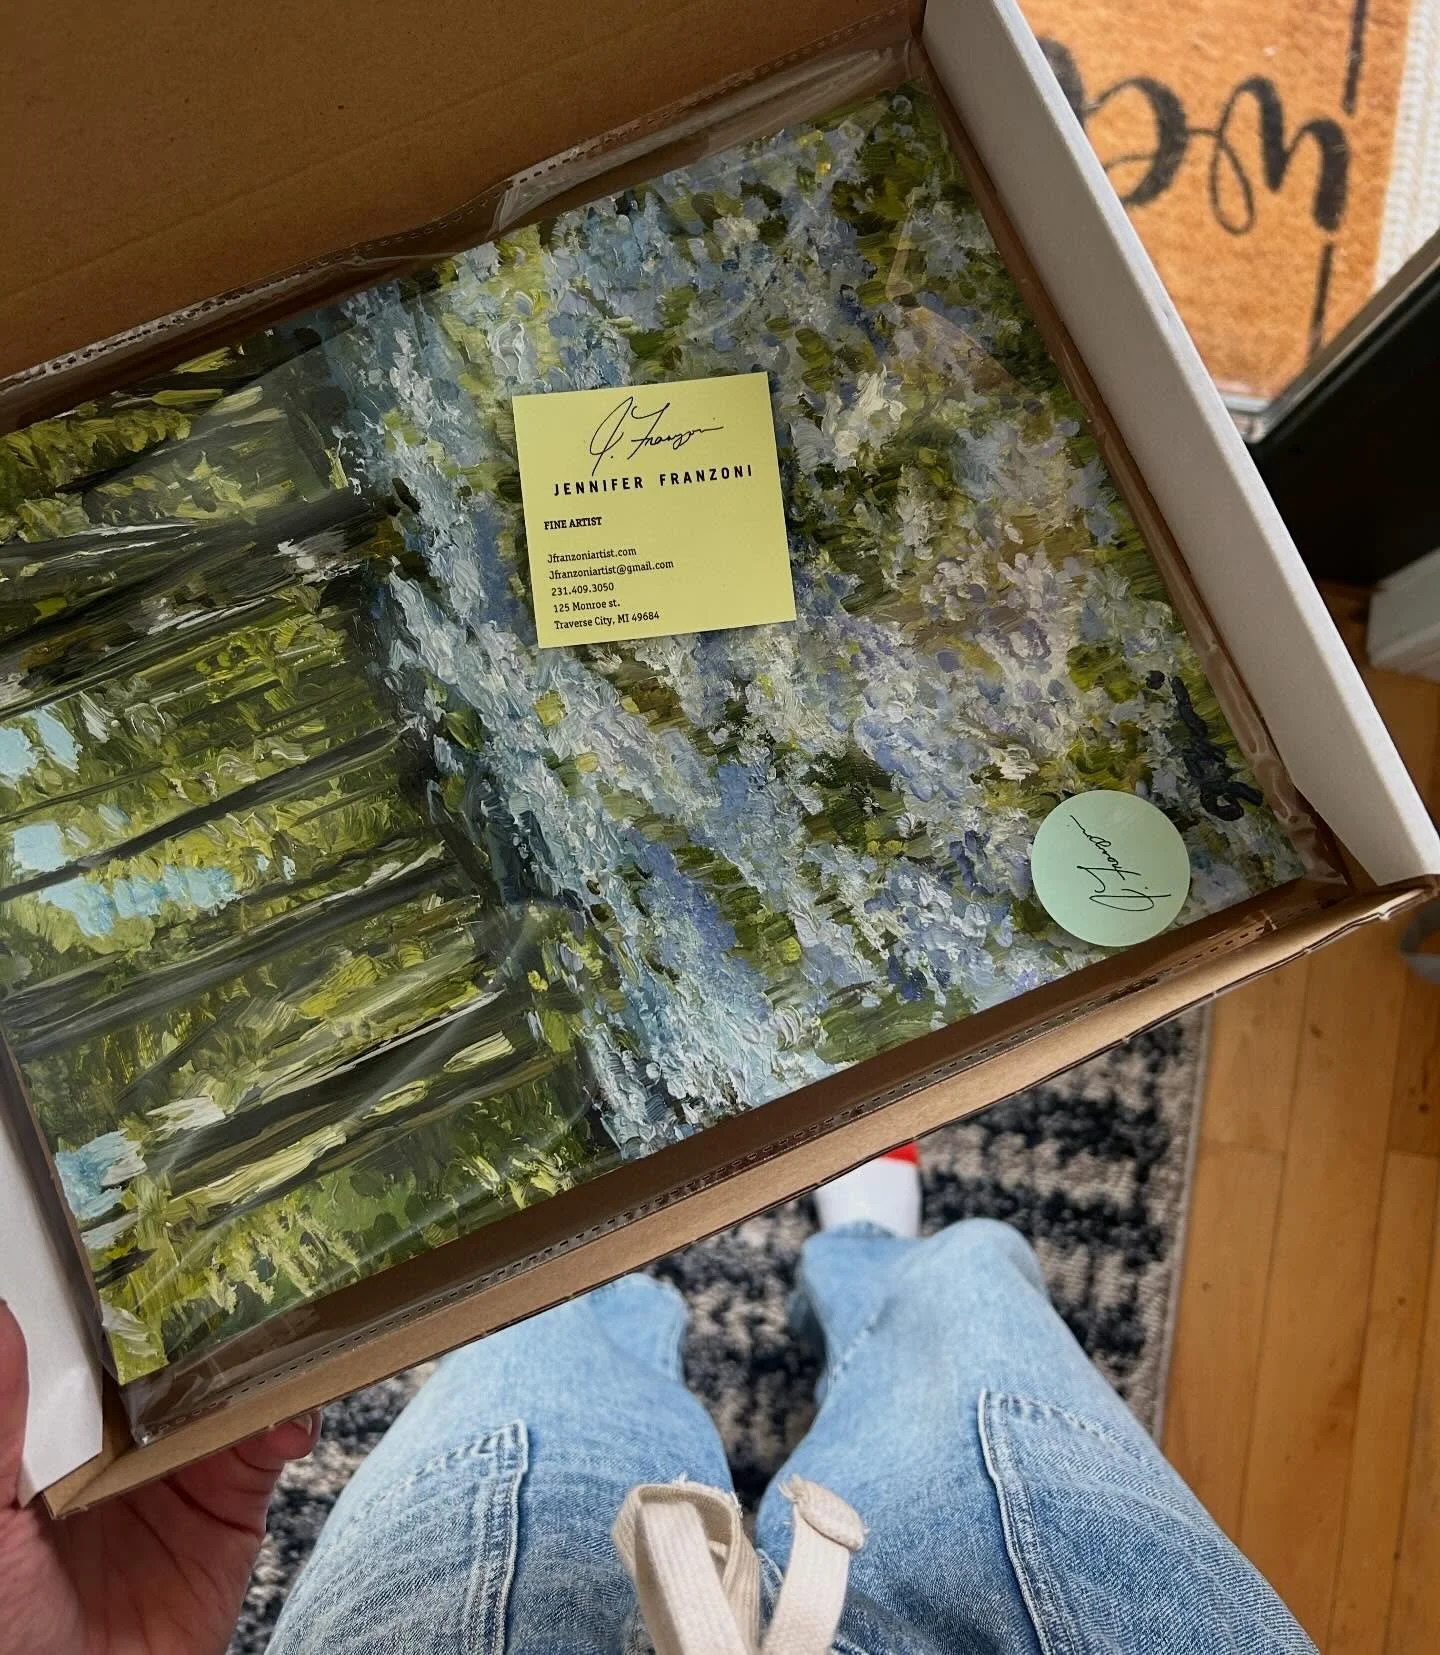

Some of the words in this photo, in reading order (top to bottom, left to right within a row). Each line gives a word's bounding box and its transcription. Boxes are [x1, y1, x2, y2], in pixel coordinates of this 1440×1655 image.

[1034, 33, 1350, 236] we
[554, 476, 644, 496] JENNIFER
[659, 464, 753, 486] FRANZONI
[543, 519, 567, 530] FINE
[568, 516, 603, 529] ARTIST
[547, 547, 637, 564] Jfranzoniartist.com
[548, 560, 675, 580] Jfranzoniartist@gmail.com
[551, 582, 615, 597] 231.409.3050
[553, 603, 570, 613] 125
[572, 600, 607, 612] Monroe
[608, 598, 621, 608] st.
[554, 618, 593, 630] Traverse
[594, 615, 615, 627] City,
[617, 613, 630, 624] MI
[631, 611, 660, 622] 49684
